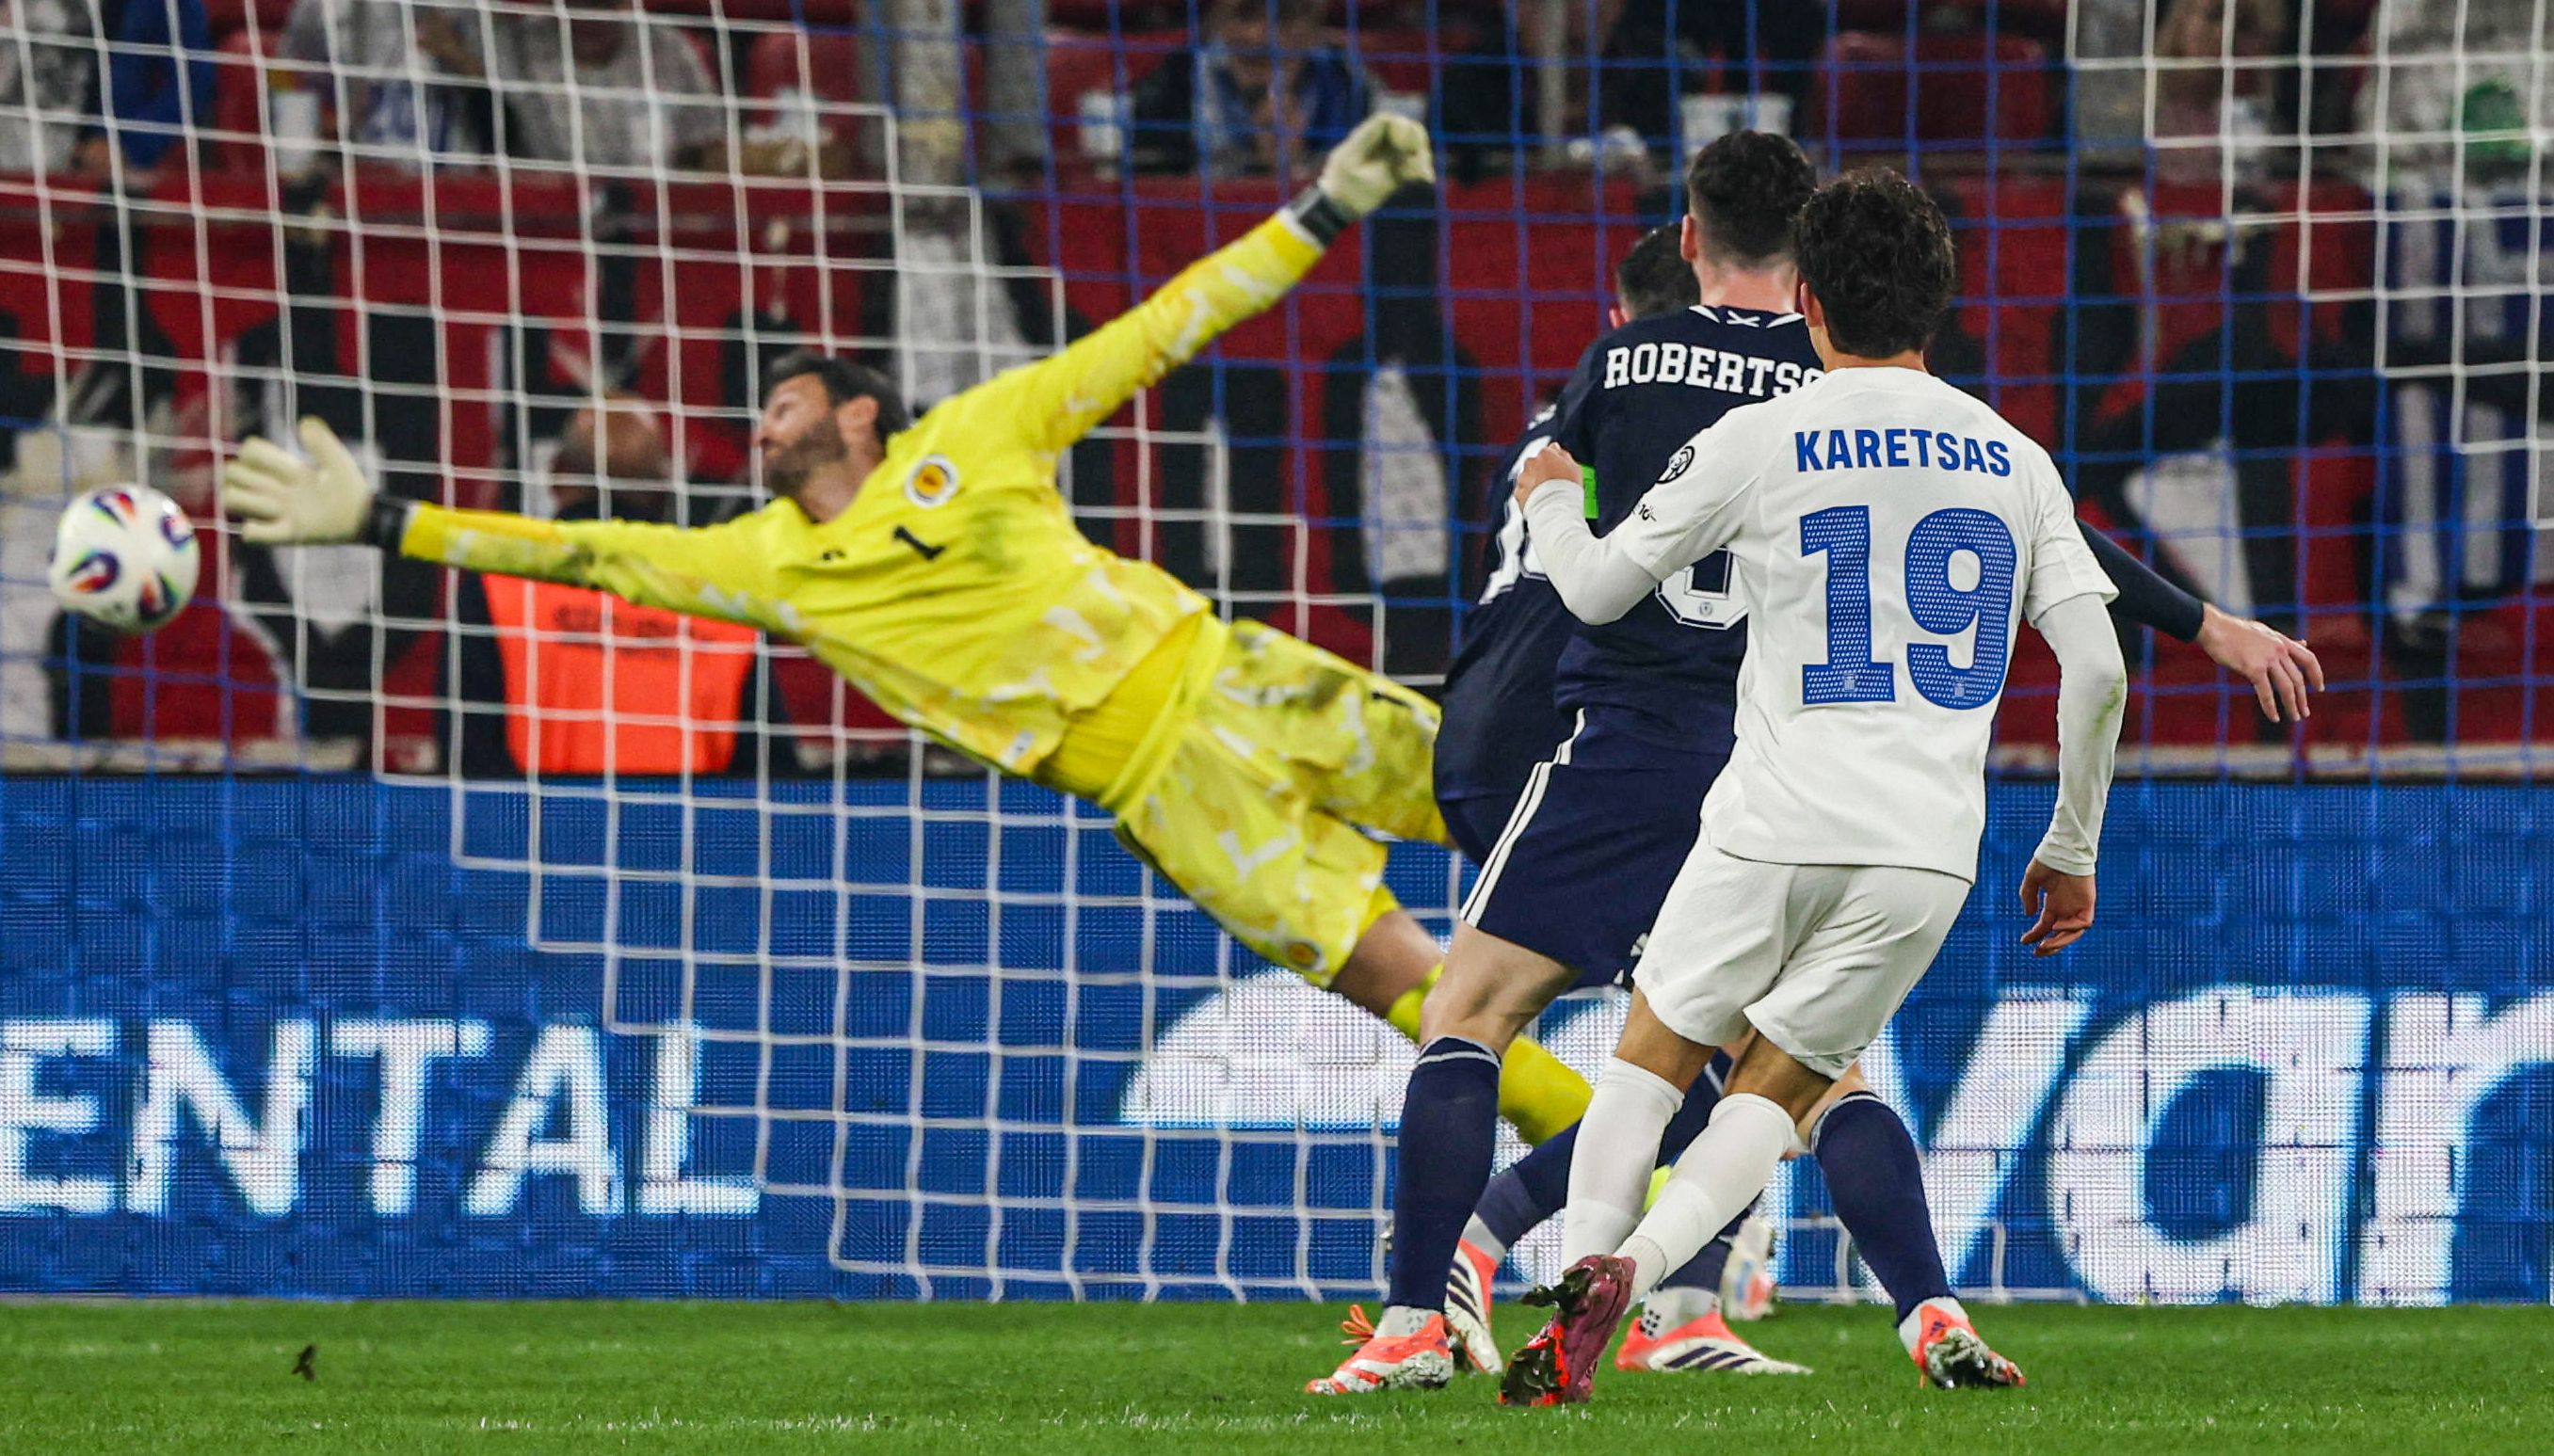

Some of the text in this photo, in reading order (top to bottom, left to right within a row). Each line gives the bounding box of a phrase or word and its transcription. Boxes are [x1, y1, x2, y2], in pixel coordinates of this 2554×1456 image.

[1794, 428, 2012, 477] KARETSAS
[1800, 505, 2017, 711] 19
[0, 1016, 760, 1214] ENTAL
